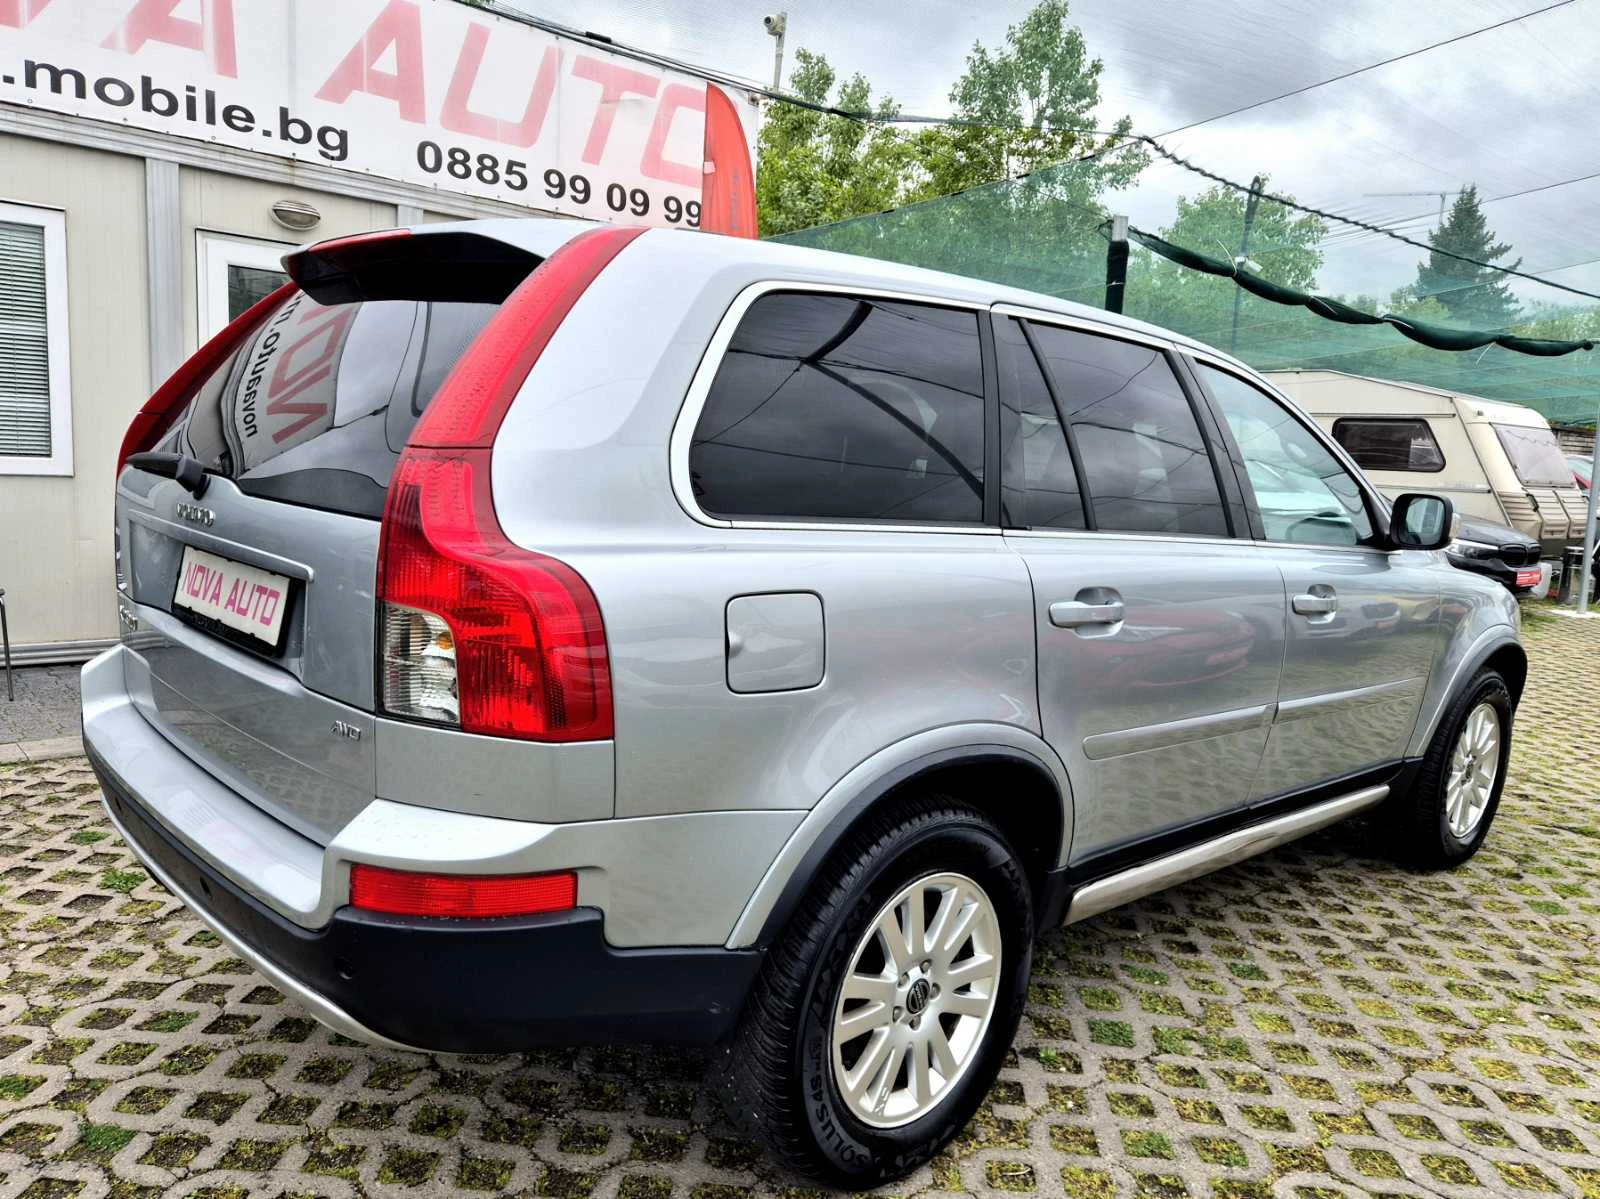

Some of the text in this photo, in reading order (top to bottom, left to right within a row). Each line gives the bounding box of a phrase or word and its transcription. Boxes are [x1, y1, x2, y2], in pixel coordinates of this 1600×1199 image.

[0, 0, 737, 188] A AUTO
[417, 140, 528, 191] 0885
[543, 168, 592, 204] 99
[606, 183, 650, 217] 09
[663, 195, 702, 228] 99
[181, 561, 225, 607] NOVA
[224, 577, 281, 627] AUTO
[816, 1104, 869, 1165] SOLUS
